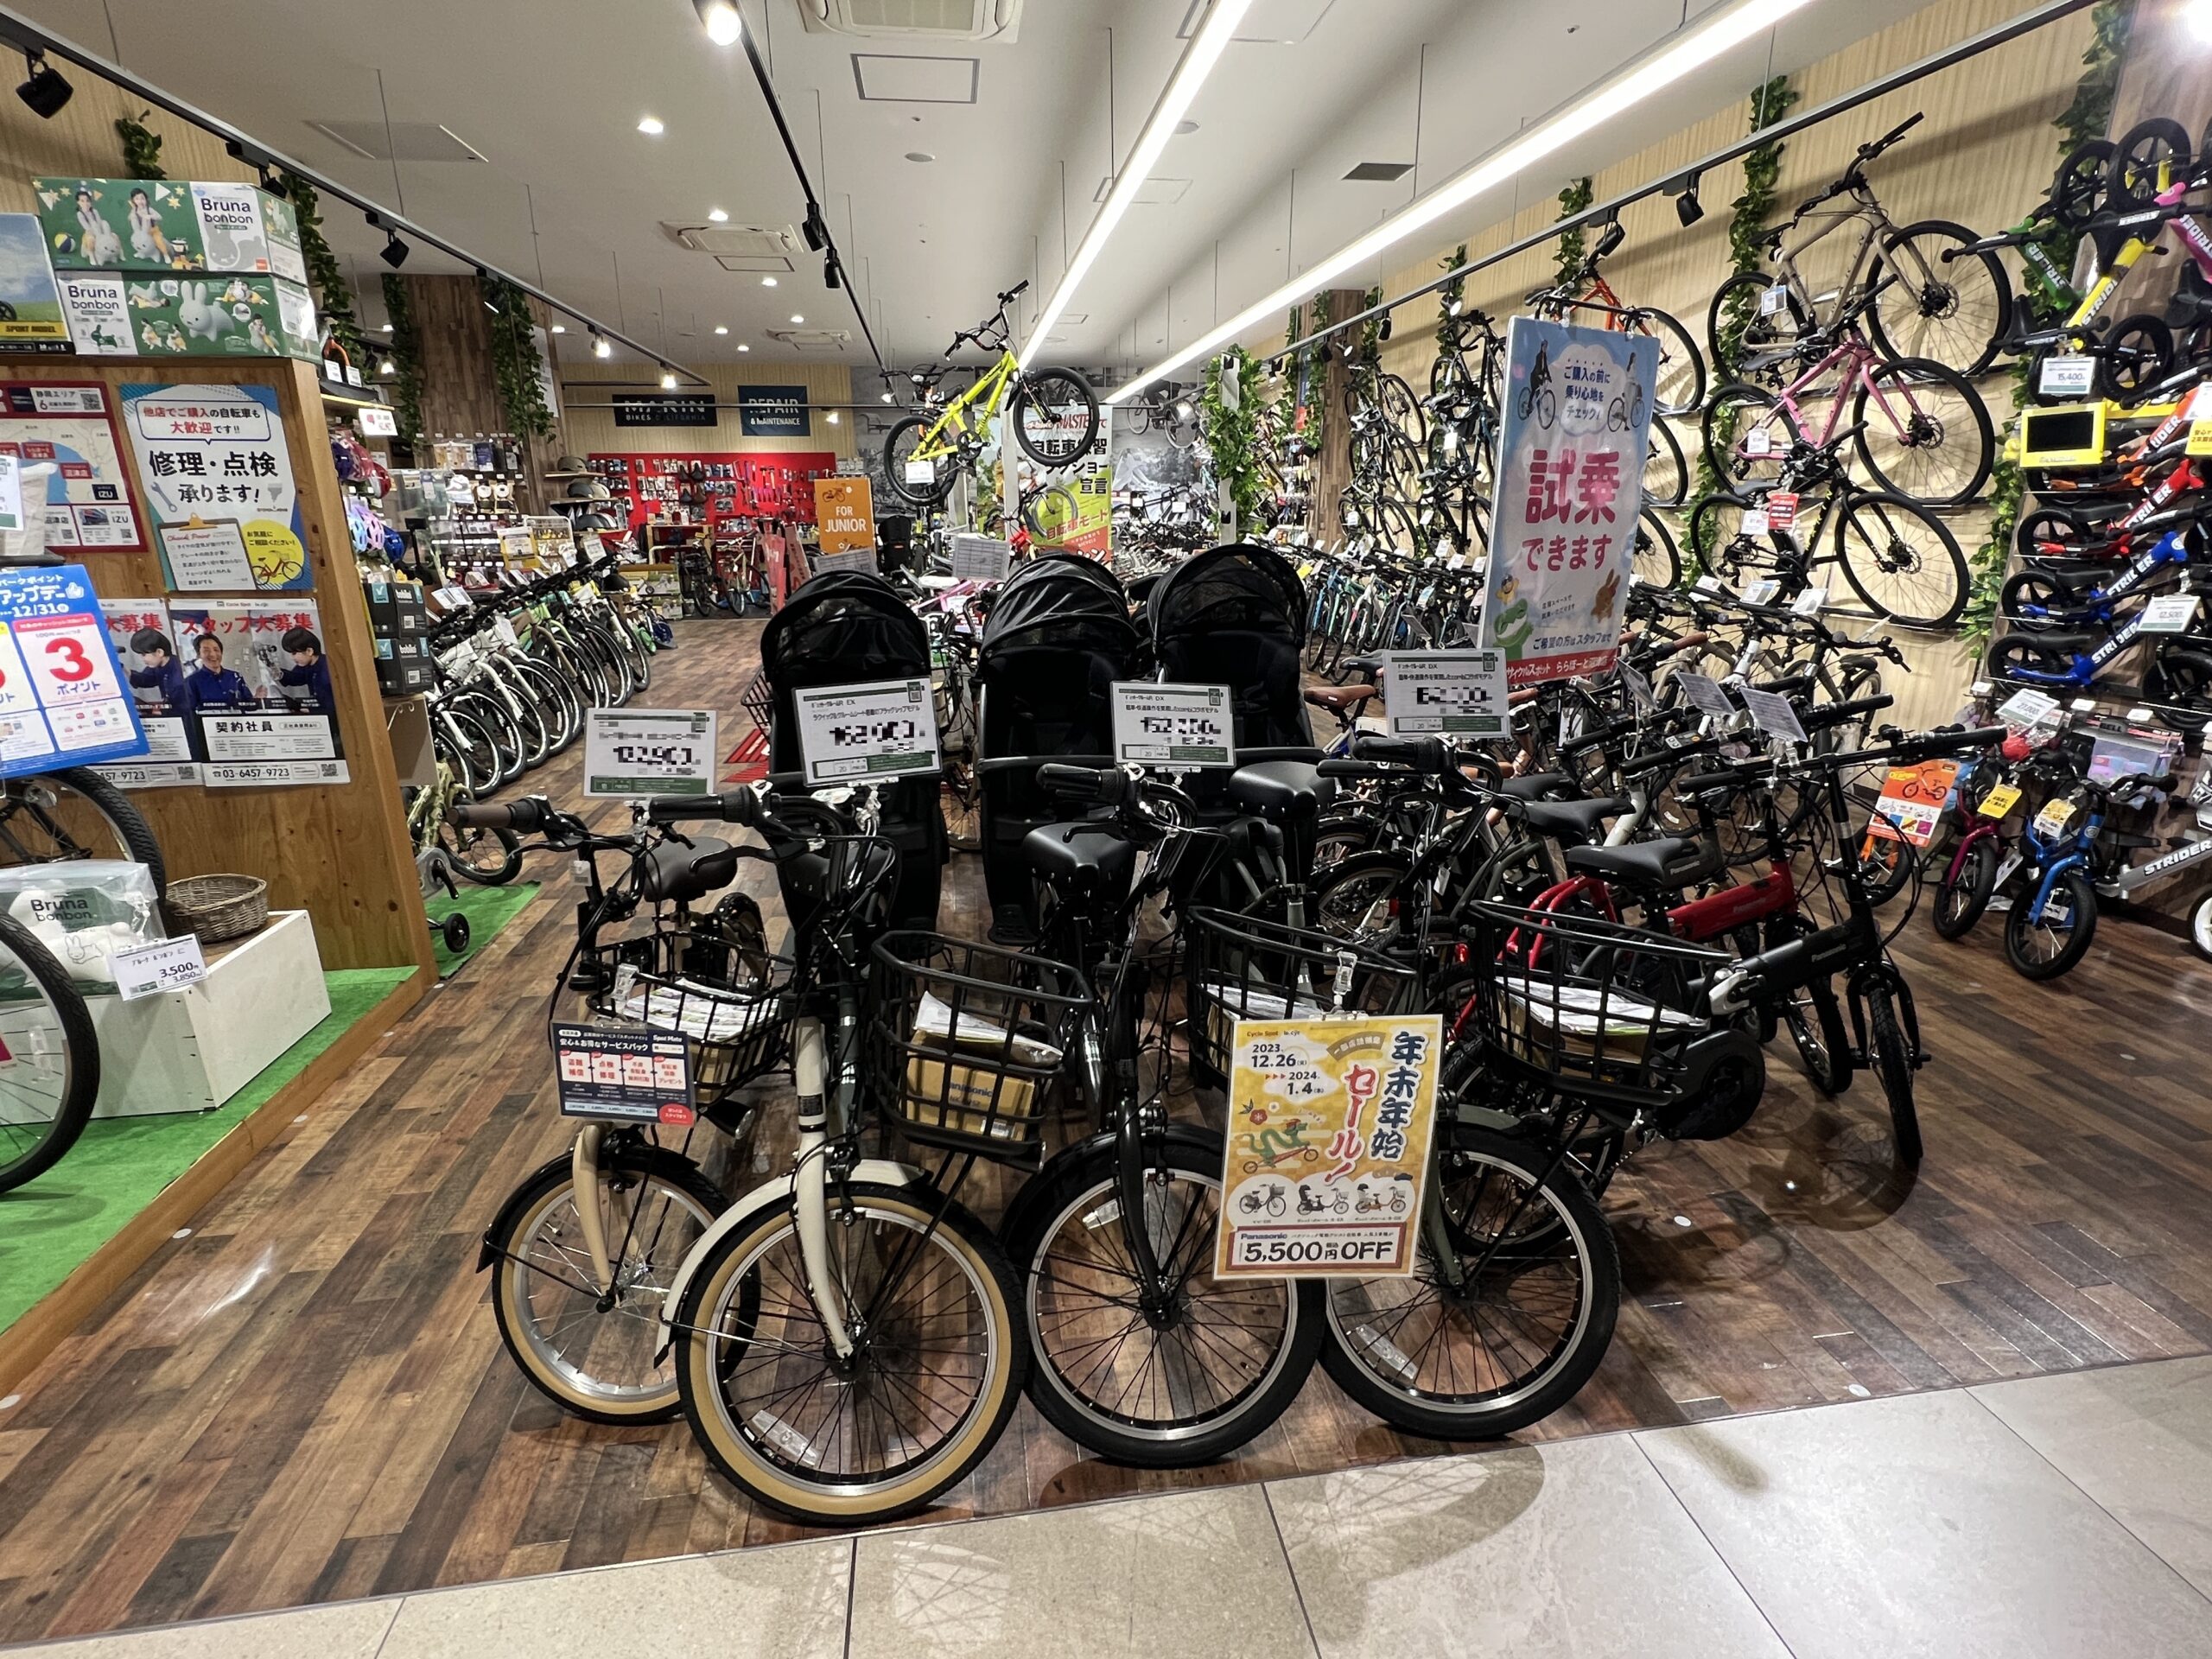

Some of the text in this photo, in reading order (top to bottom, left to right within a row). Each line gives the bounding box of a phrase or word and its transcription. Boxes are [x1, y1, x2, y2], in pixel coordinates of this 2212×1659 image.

[200, 198, 251, 213] Bruna
[204, 213, 253, 224] bonbon
[67, 285, 118, 298] Bruna
[71, 300, 119, 309] bonbon
[1564, 365, 1611, 384] ご購入の前に
[1565, 385, 1605, 402] 乗り心地を
[40, 400, 48, 410] 6
[143, 407, 260, 419] 他店でご購入の自転車も
[1032, 438, 1107, 455] 自転車習
[149, 450, 278, 477] 修理・点検
[178, 484, 259, 503] 承ります!
[1080, 478, 1107, 494] 宣言
[1525, 448, 1620, 525] 試乗
[836, 506, 853, 516] FOR
[825, 519, 867, 532] JUNIOR
[1522, 534, 1612, 572] できます
[181, 613, 315, 635] スタッフ大募集
[1533, 632, 1611, 650] ご希望の方はスタッフまで
[45, 637, 93, 682] 3
[1506, 663, 1550, 679] サイクルスポット
[57, 680, 101, 696] ポイント
[216, 721, 274, 733] 契約社員
[2101, 723, 2123, 732] BELL
[223, 768, 289, 779] 03-6457-9723
[2144, 840, 2212, 876] STRIDER
[30, 899, 88, 911] Bruna
[35, 912, 92, 921] bonbon
[1253, 1044, 1284, 1052] 2023.
[950, 1082, 993, 1097] anasonic
[1371, 1031, 1426, 1159] 年末年始
[1341, 1242, 1393, 1260] OFF
